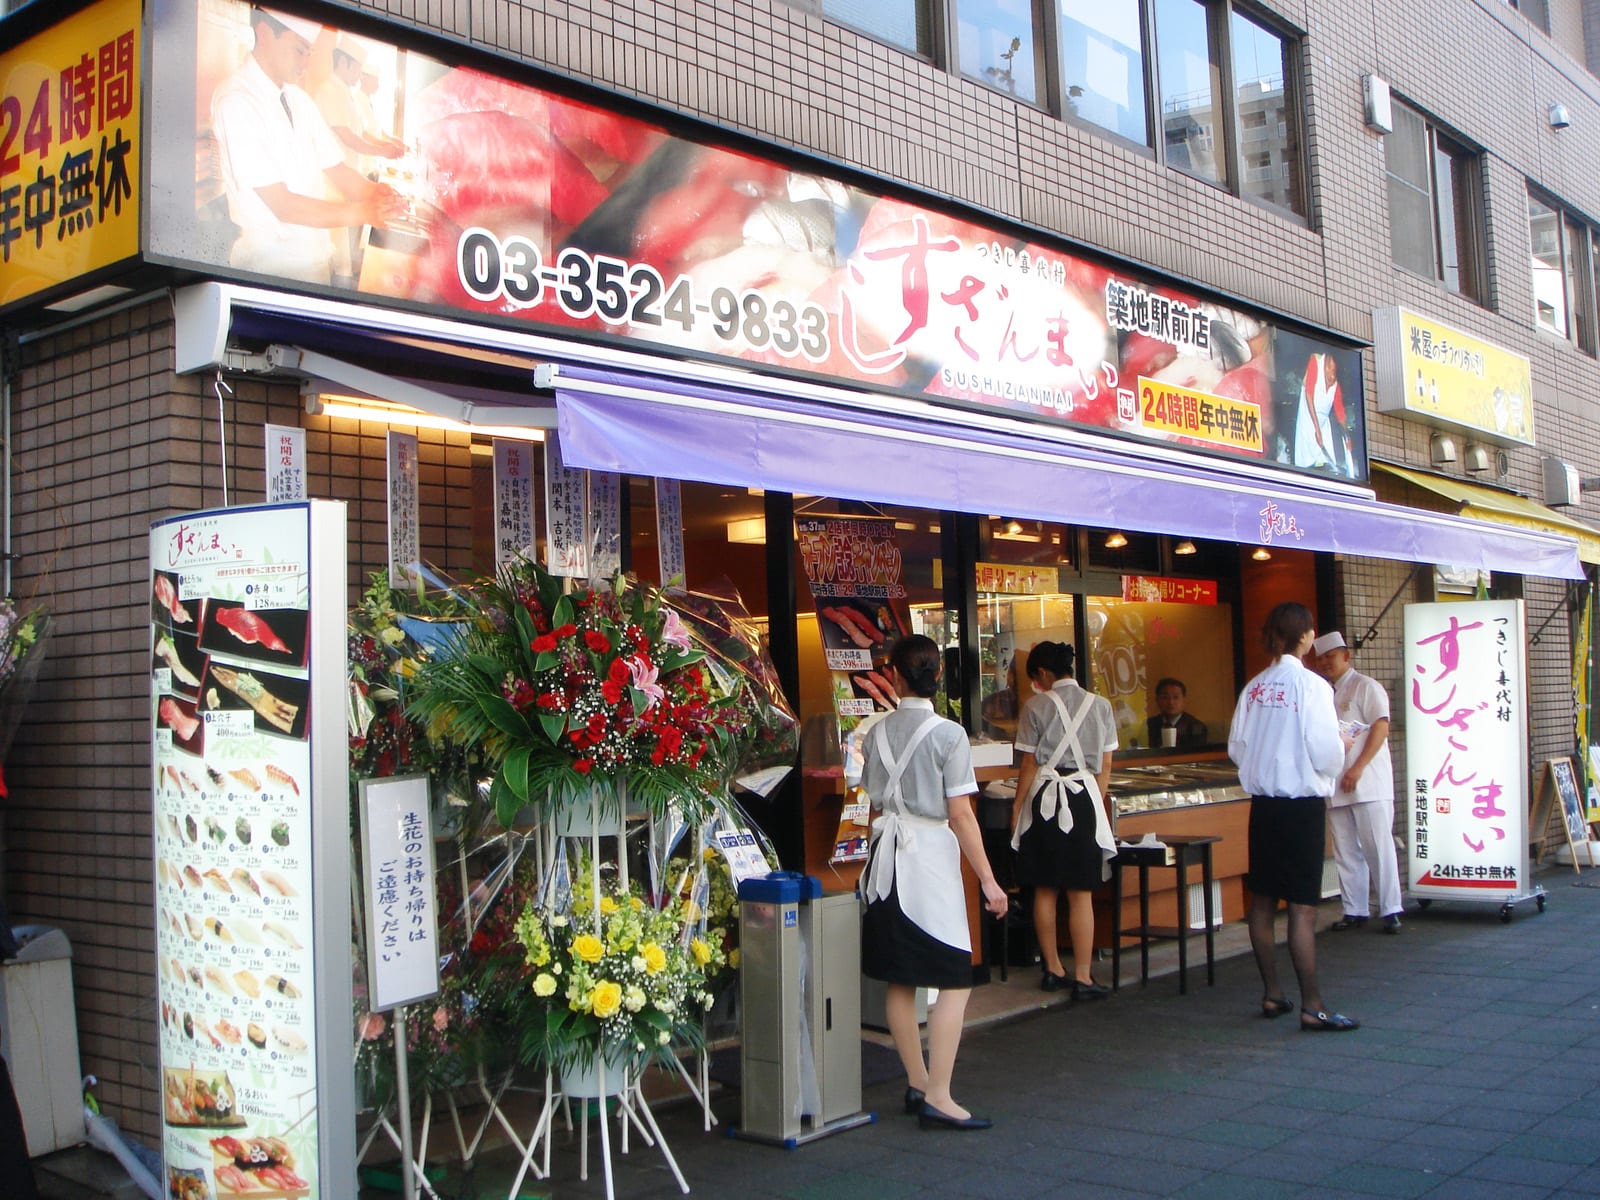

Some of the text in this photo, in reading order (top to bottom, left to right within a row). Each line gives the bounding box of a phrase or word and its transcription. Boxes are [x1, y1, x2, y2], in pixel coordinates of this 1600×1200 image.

[0, 29, 134, 178] 24時間
[0, 128, 132, 263] 年中無休
[460, 230, 829, 361] 03-3524-9833
[840, 215, 1118, 400] すしざんまい
[976, 243, 1067, 286] つきじ喜代村
[1106, 279, 1212, 350] 築地駅前店
[943, 368, 1074, 407] SUSHIZANMAI
[1142, 386, 1261, 443] 24時間年中無休
[280, 435, 293, 467] 祝開店
[1412, 616, 1507, 853] すしざんまい
[1416, 779, 1429, 859] 築地駅前店
[377, 859, 402, 963] ご遠慮ください
[402, 812, 428, 942] 生花のお持ち帰りは
[1433, 864, 1517, 880] 24h年中無休
